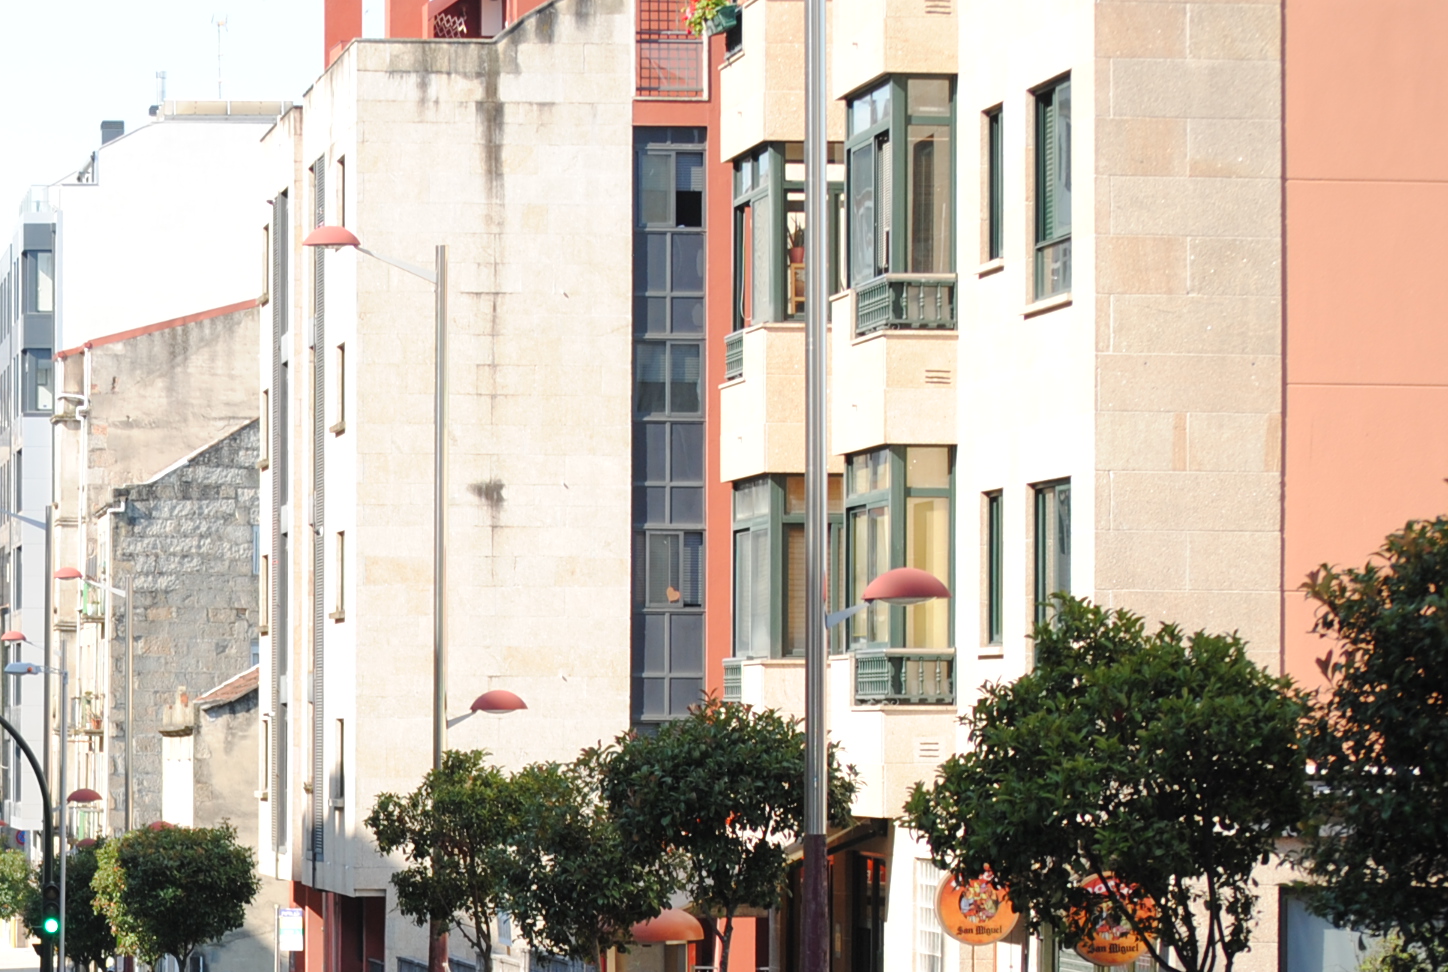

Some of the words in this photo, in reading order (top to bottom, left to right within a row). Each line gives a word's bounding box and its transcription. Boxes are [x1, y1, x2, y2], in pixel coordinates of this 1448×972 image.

[956, 925, 974, 935] San
[975, 925, 1002, 936] Miguel
[1087, 943, 1105, 954] San
[1108, 943, 1139, 955] Miguel
